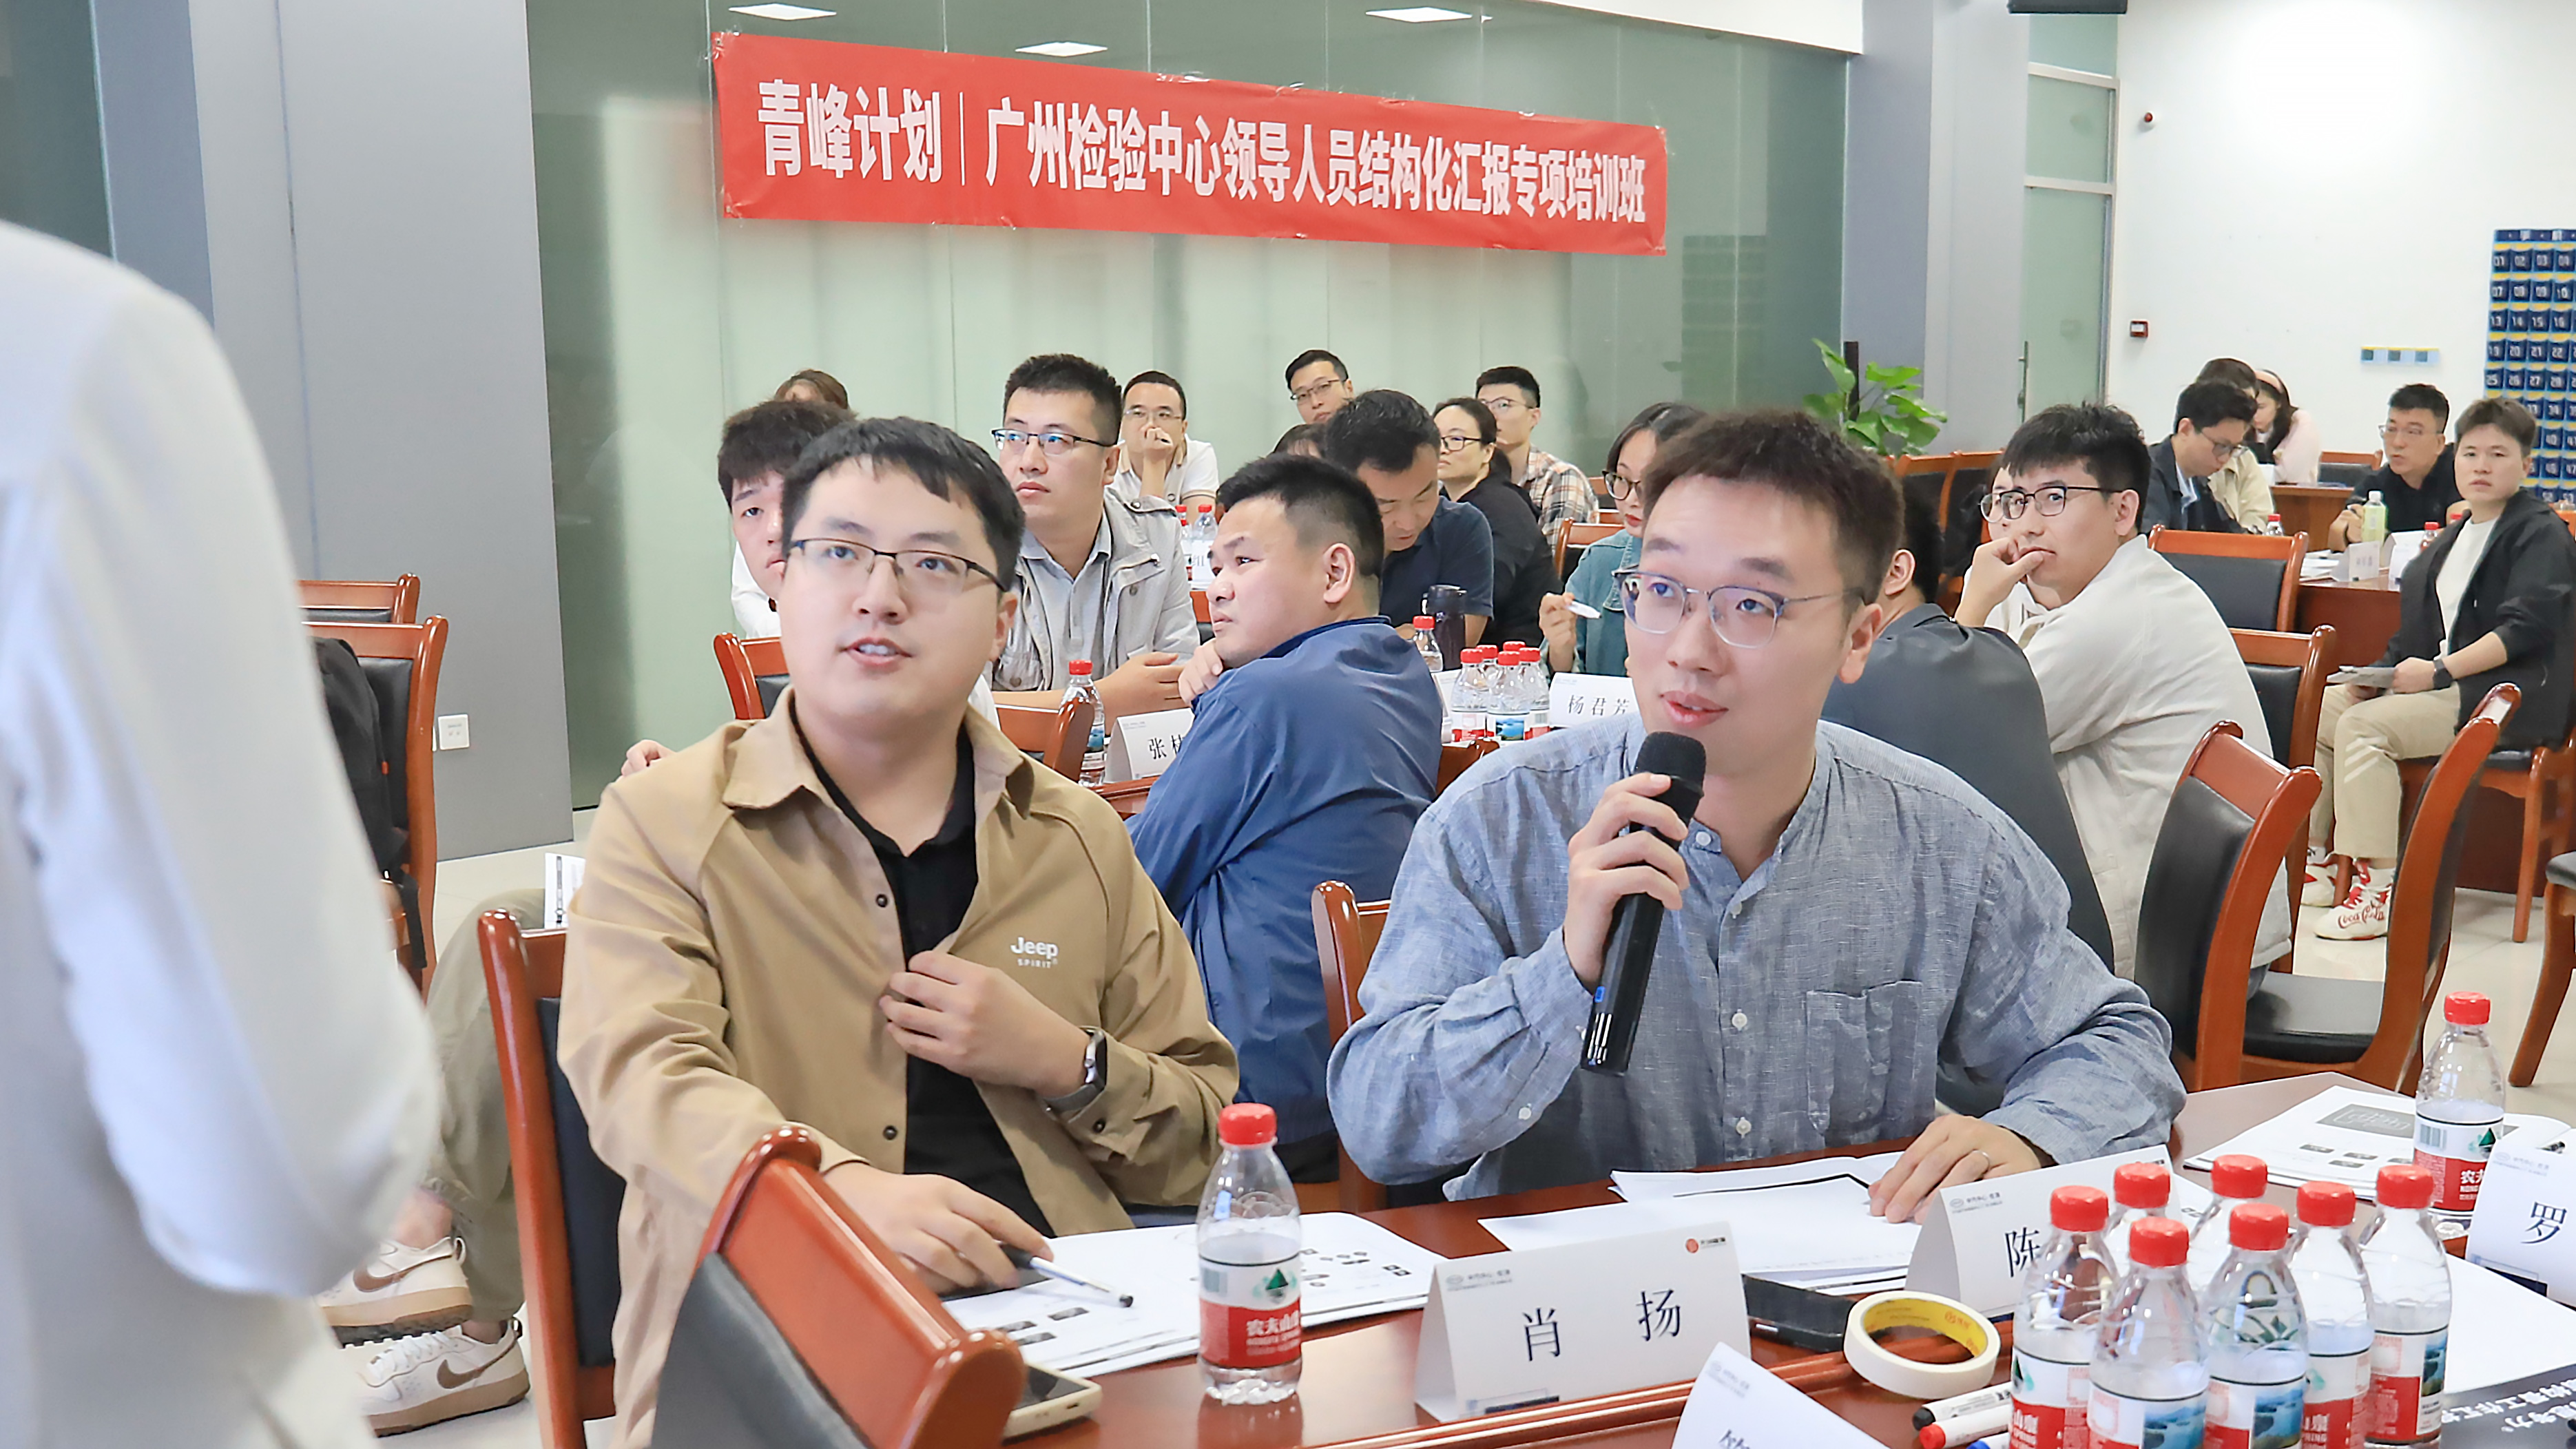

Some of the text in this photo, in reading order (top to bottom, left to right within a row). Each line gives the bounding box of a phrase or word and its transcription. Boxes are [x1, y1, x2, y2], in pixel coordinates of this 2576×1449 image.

[758, 79, 1645, 223] 青峰计划 广州检验中心领导人员结构化汇报专项培训班
[1010, 937, 1059, 959] Jeep
[2521, 1200, 2568, 1244] 罗
